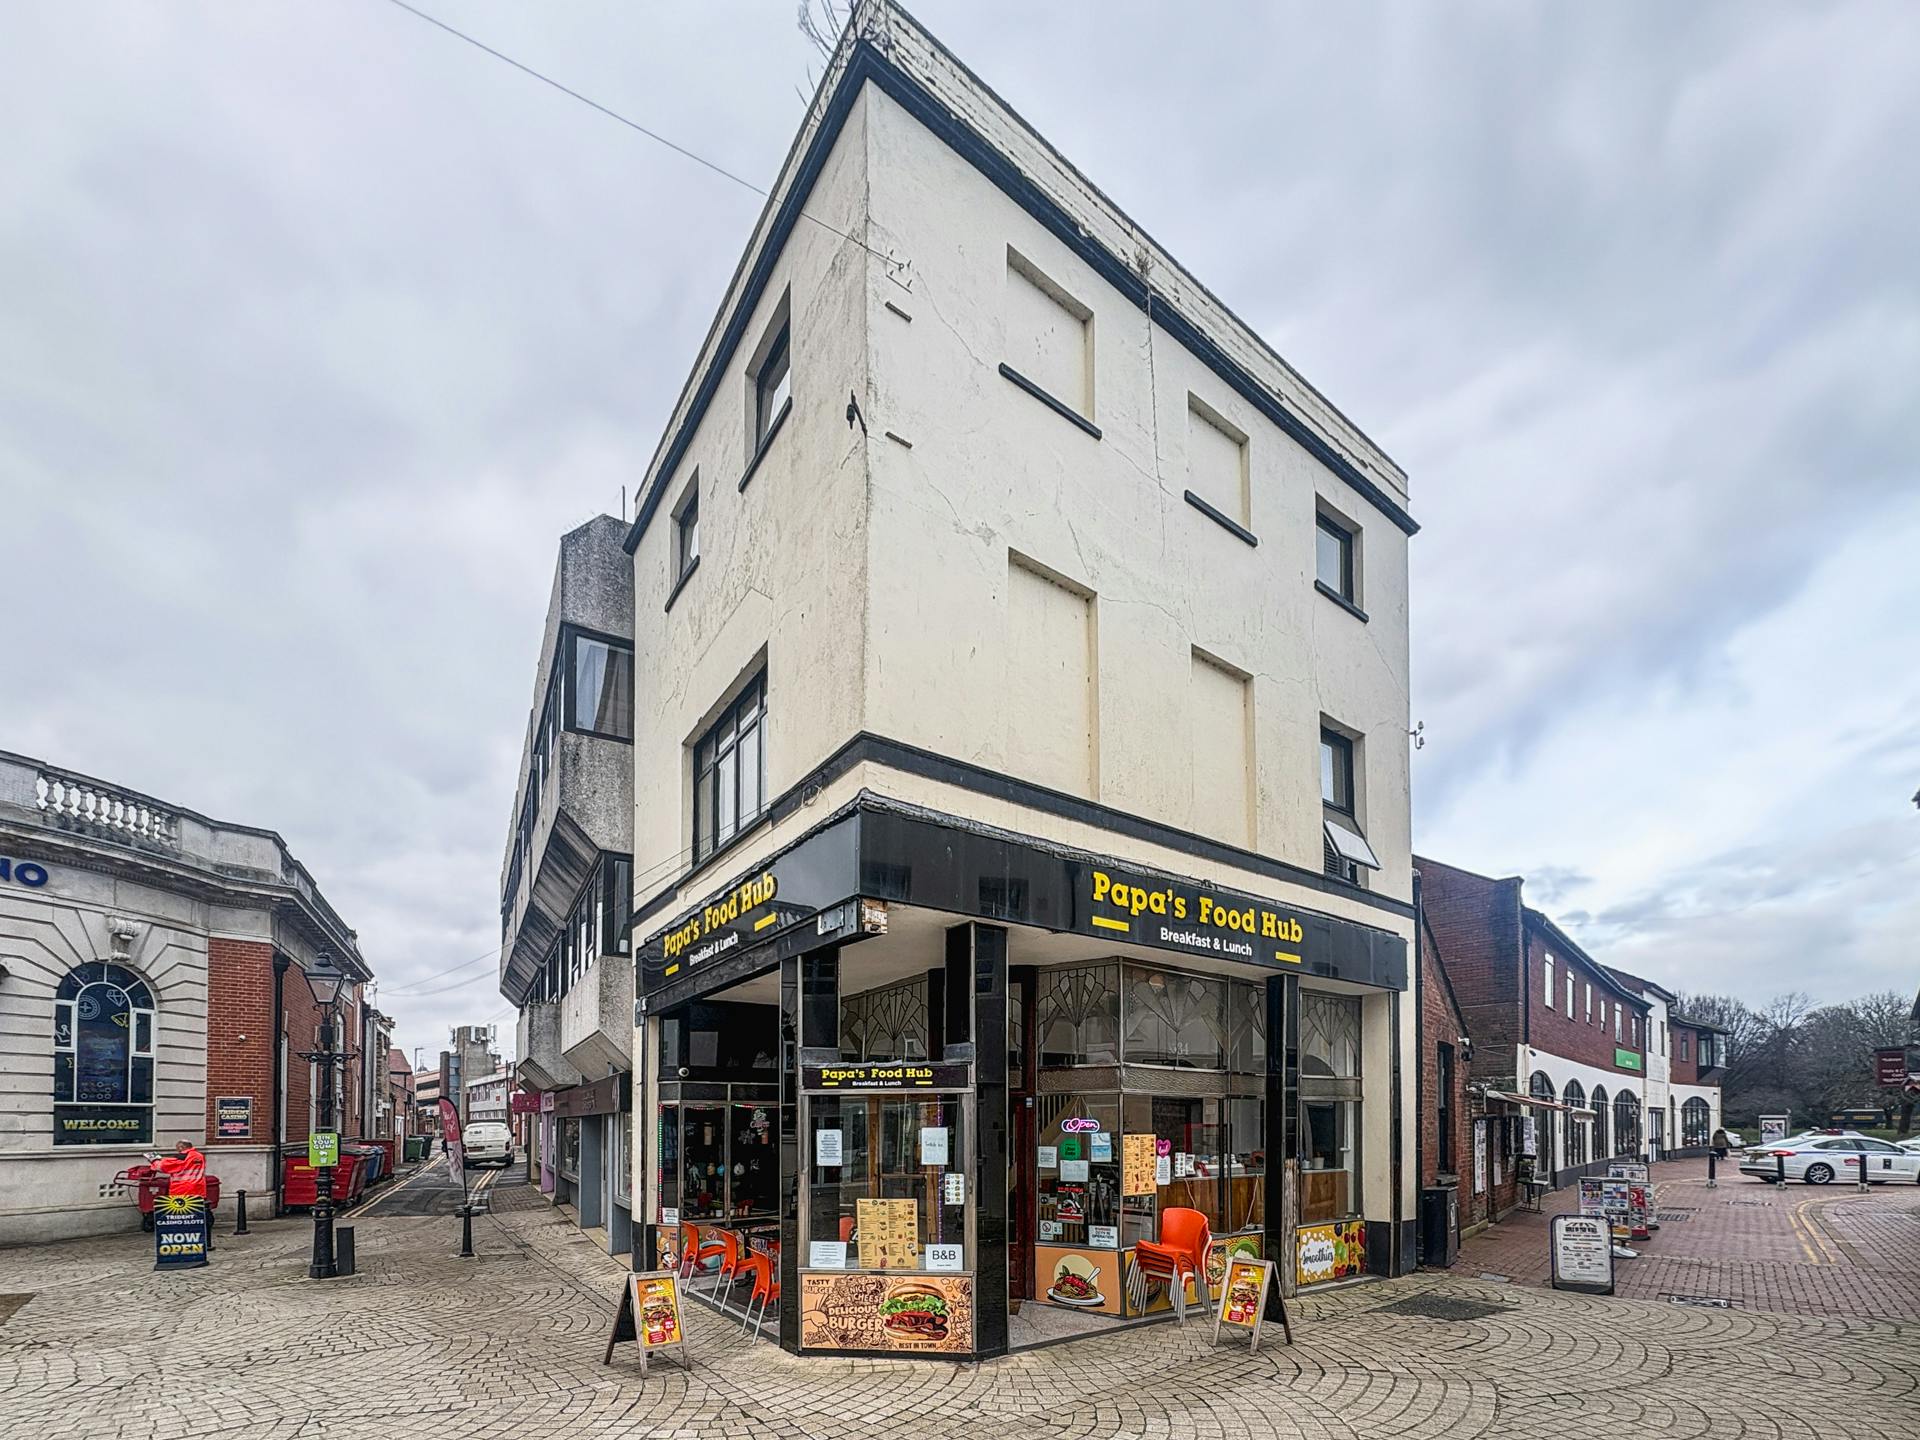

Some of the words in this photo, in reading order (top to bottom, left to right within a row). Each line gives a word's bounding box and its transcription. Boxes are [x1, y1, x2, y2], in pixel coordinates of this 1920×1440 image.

[1092, 871, 1187, 917] Papa's
[1199, 896, 1256, 934] Food
[1261, 911, 1303, 943] Hub
[663, 918, 700, 958] Papa's
[704, 891, 738, 934] Food
[741, 871, 775, 914] Hub
[1160, 926, 1211, 949] Breakfast
[1213, 937, 1221, 950] &
[1223, 939, 1252, 956] Lunch
[688, 943, 714, 967] Breakfast
[714, 941, 720, 954] &
[720, 931, 739, 951] Lunch
[821, 1068, 865, 1080] Papa's
[871, 1068, 903, 1078] Food
[906, 1068, 933, 1077] Hub
[63, 1119, 140, 1130] WELCOME
[1066, 1117, 1098, 1133] Open
[160, 1232, 201, 1244] NOW
[160, 1243, 204, 1255] OPEN
[932, 1250, 956, 1260] B&B
[1302, 1247, 1334, 1265] Smoothies
[803, 1286, 834, 1294] BURGER
[853, 1293, 884, 1304] CHEESE
[828, 1305, 878, 1316] DELICIOUS
[828, 1316, 884, 1332] BURGER
